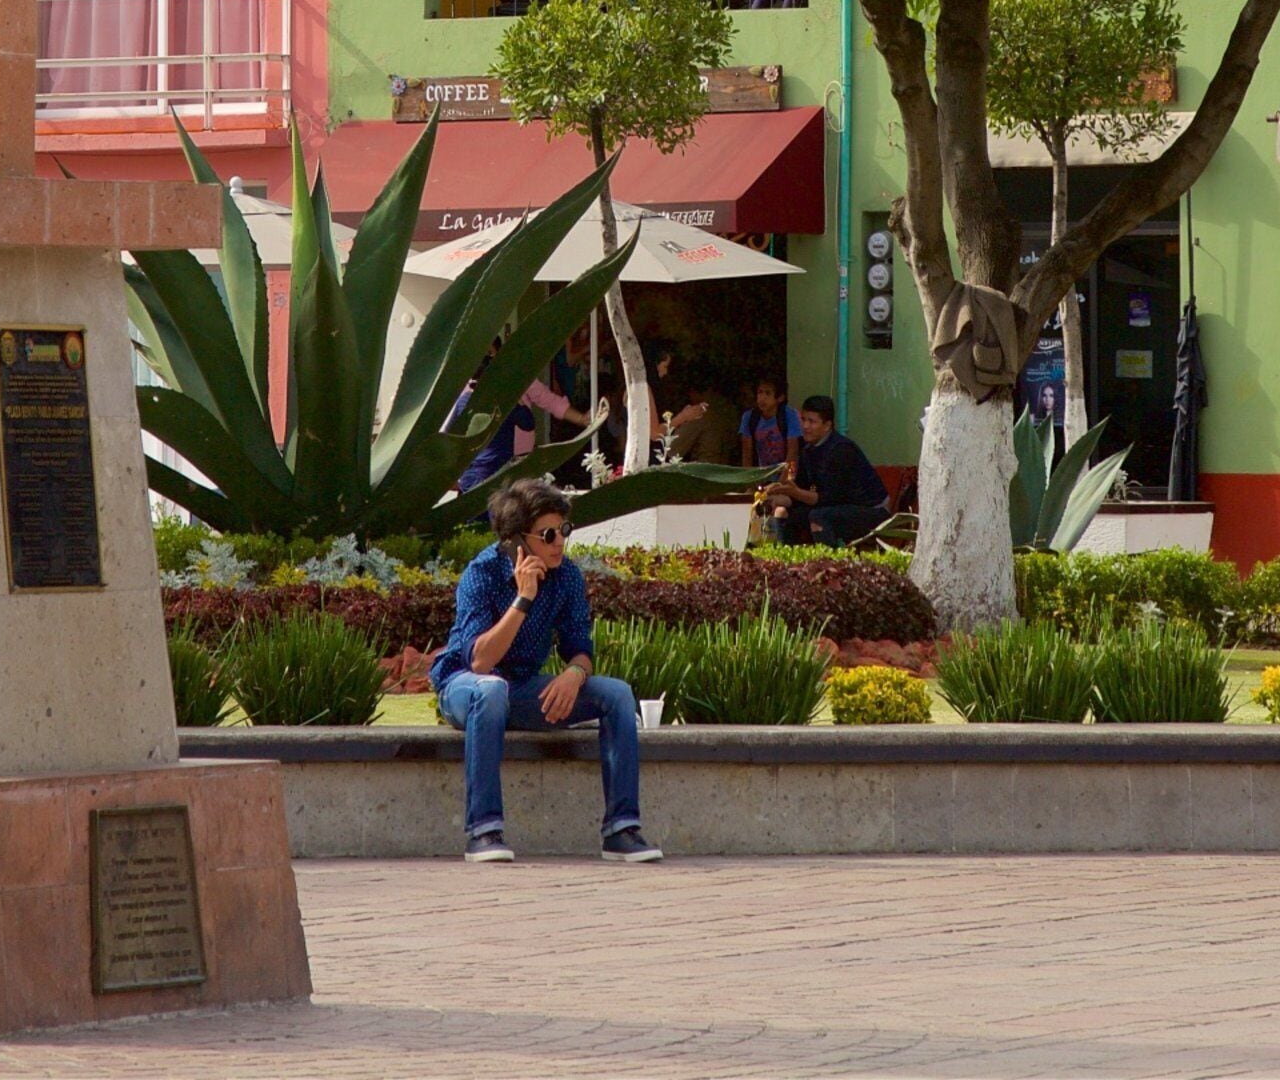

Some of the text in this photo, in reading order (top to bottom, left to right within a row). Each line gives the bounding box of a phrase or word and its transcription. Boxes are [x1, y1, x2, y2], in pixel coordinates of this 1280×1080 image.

[425, 83, 489, 103] COFFEE
[438, 213, 467, 230] La
[671, 210, 715, 226] TECATE
